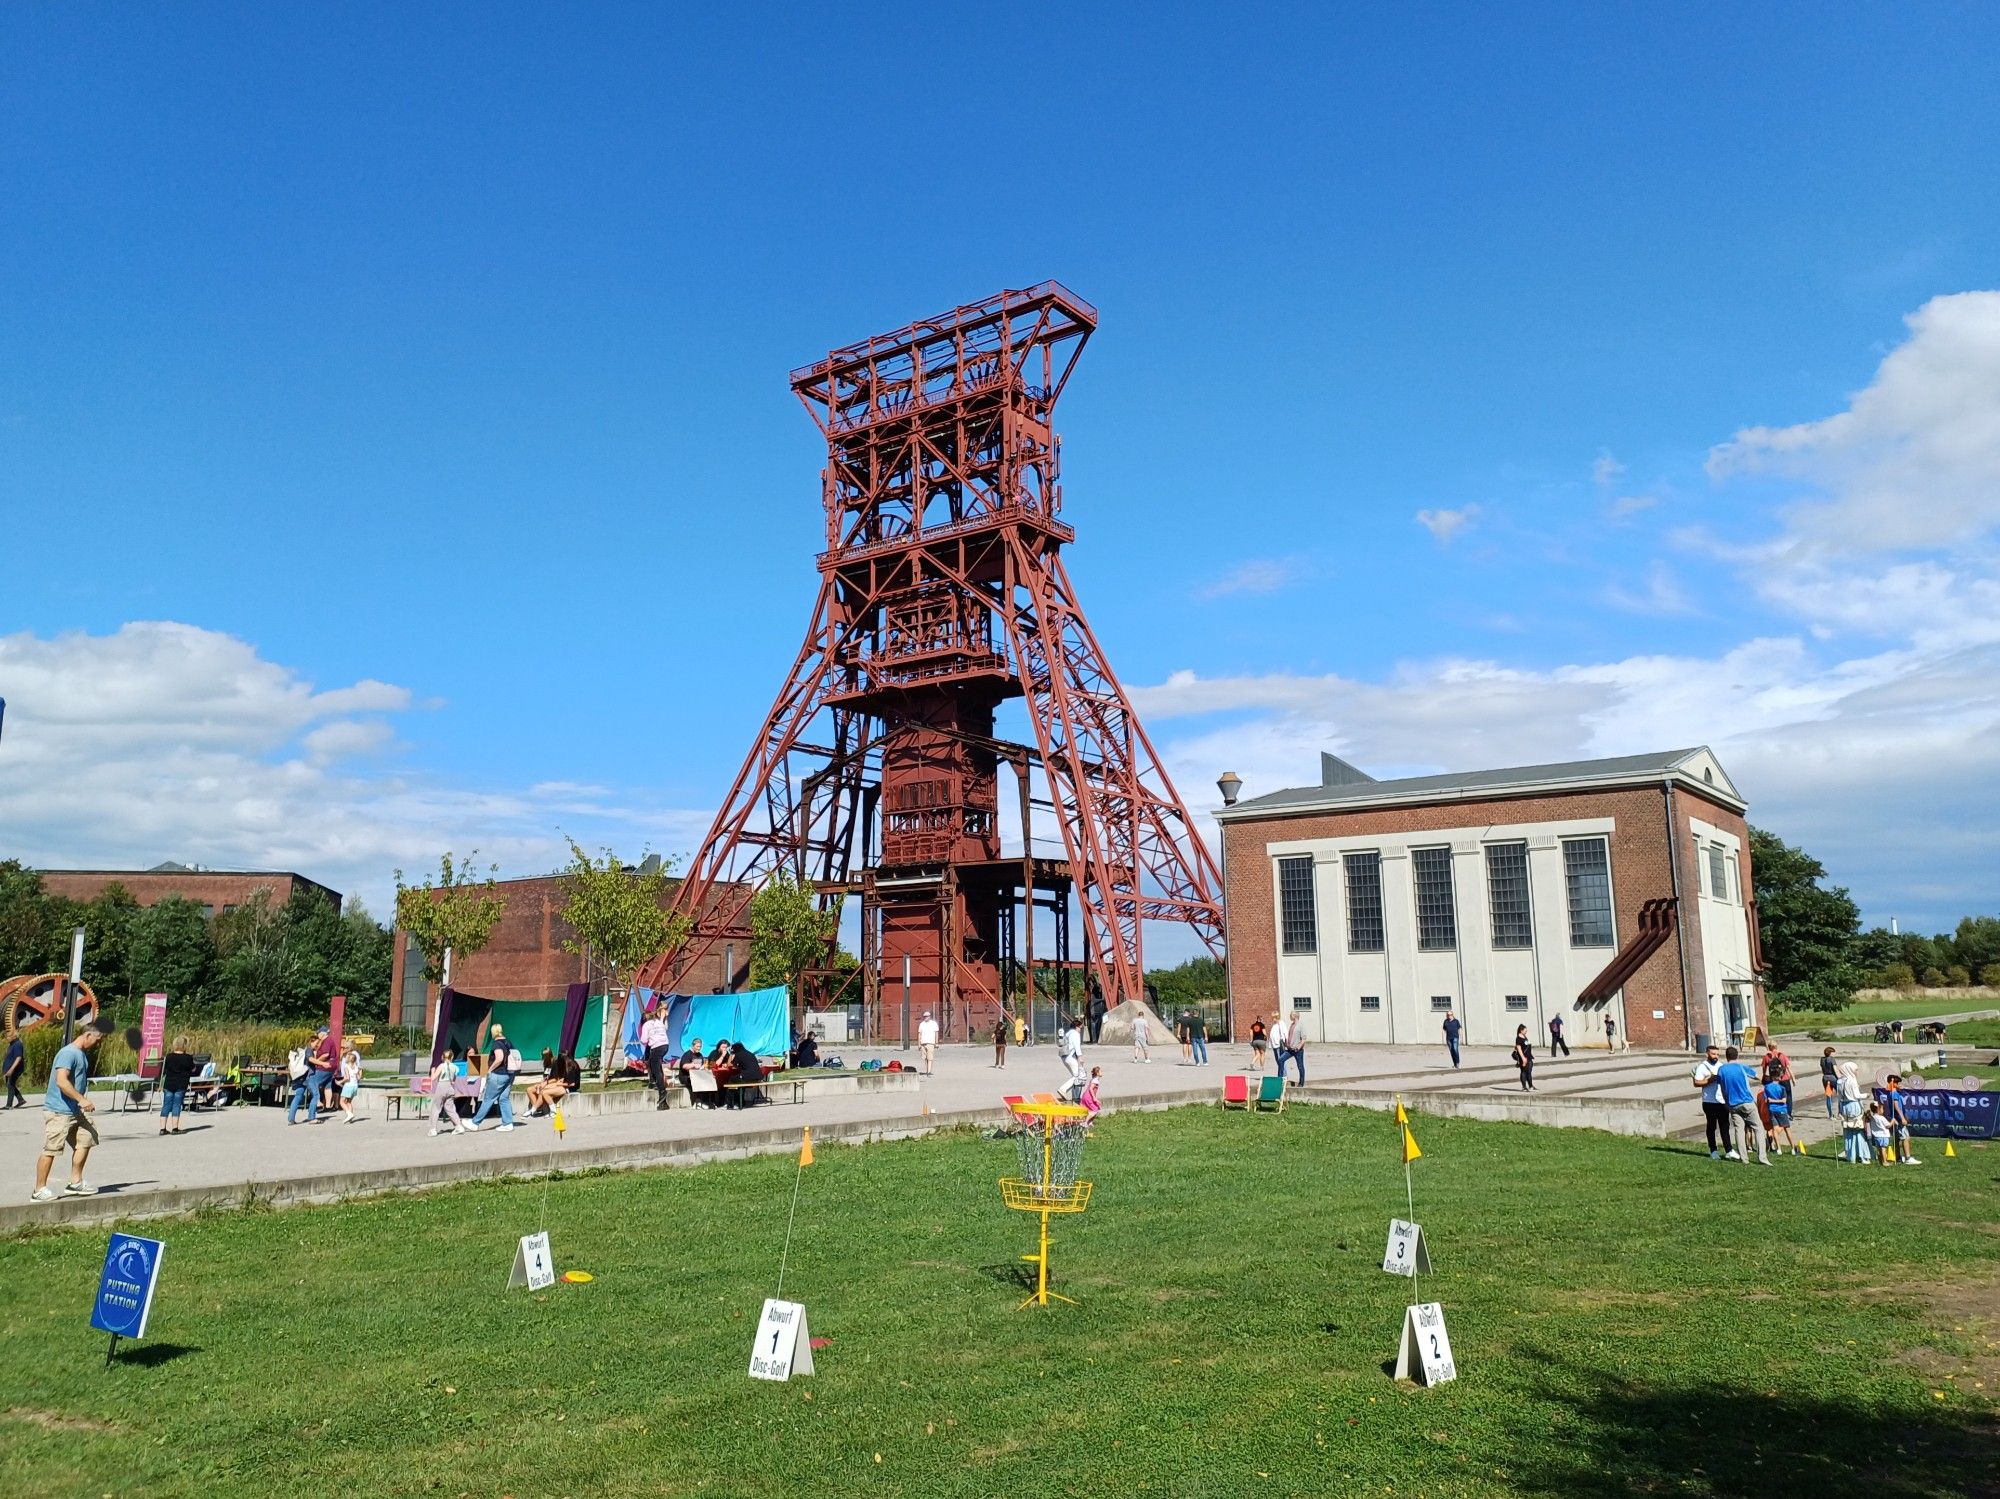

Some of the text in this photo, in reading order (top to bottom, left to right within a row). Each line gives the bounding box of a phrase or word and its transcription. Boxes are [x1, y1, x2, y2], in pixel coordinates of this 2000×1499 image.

[1880, 1094, 1990, 1107] FYING DISC
[1397, 1241, 1405, 1259] 3
[536, 1253, 542, 1271] 4
[106, 1279, 140, 1295] PUTTING
[104, 1293, 138, 1310] STATION
[768, 1307, 793, 1324] Abwurf
[772, 1329, 780, 1355] 1
[1430, 1333, 1441, 1360] 2
[753, 1356, 787, 1377] Disc-Golf
